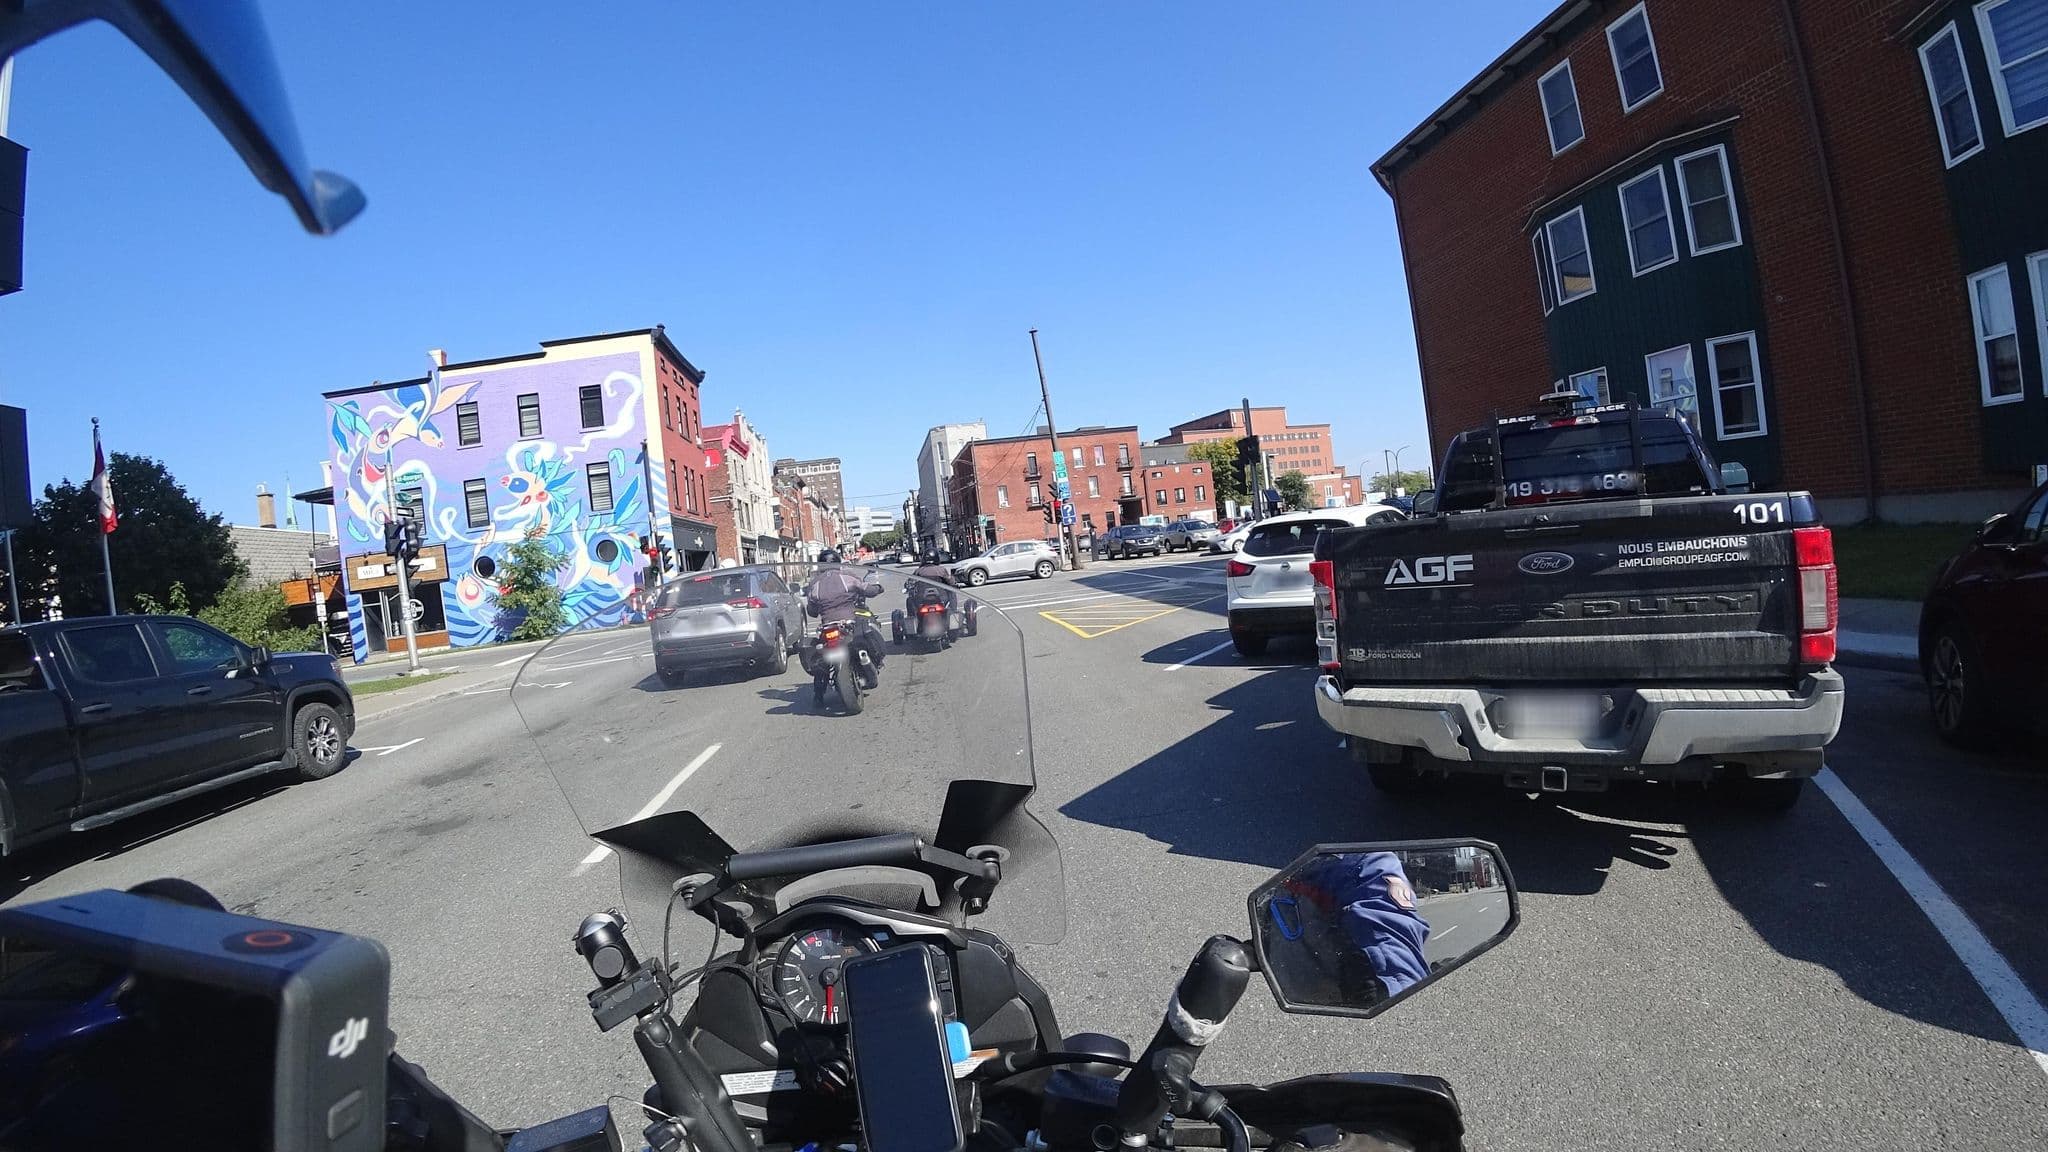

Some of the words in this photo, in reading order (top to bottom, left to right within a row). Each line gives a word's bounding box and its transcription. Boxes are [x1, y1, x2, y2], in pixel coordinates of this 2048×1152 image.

[1585, 403, 1626, 414] RACK
[1732, 502, 1784, 524] 101
[1618, 542, 1653, 554] NOUS
[1657, 536, 1748, 552] EMBAUCHONS
[1530, 556, 1562, 570] Ford
[1618, 551, 1750, 568] EMPLOI@GROUPEAGF.COM
[1383, 554, 1474, 585] AGF
[1583, 594, 1753, 617] DUTY
